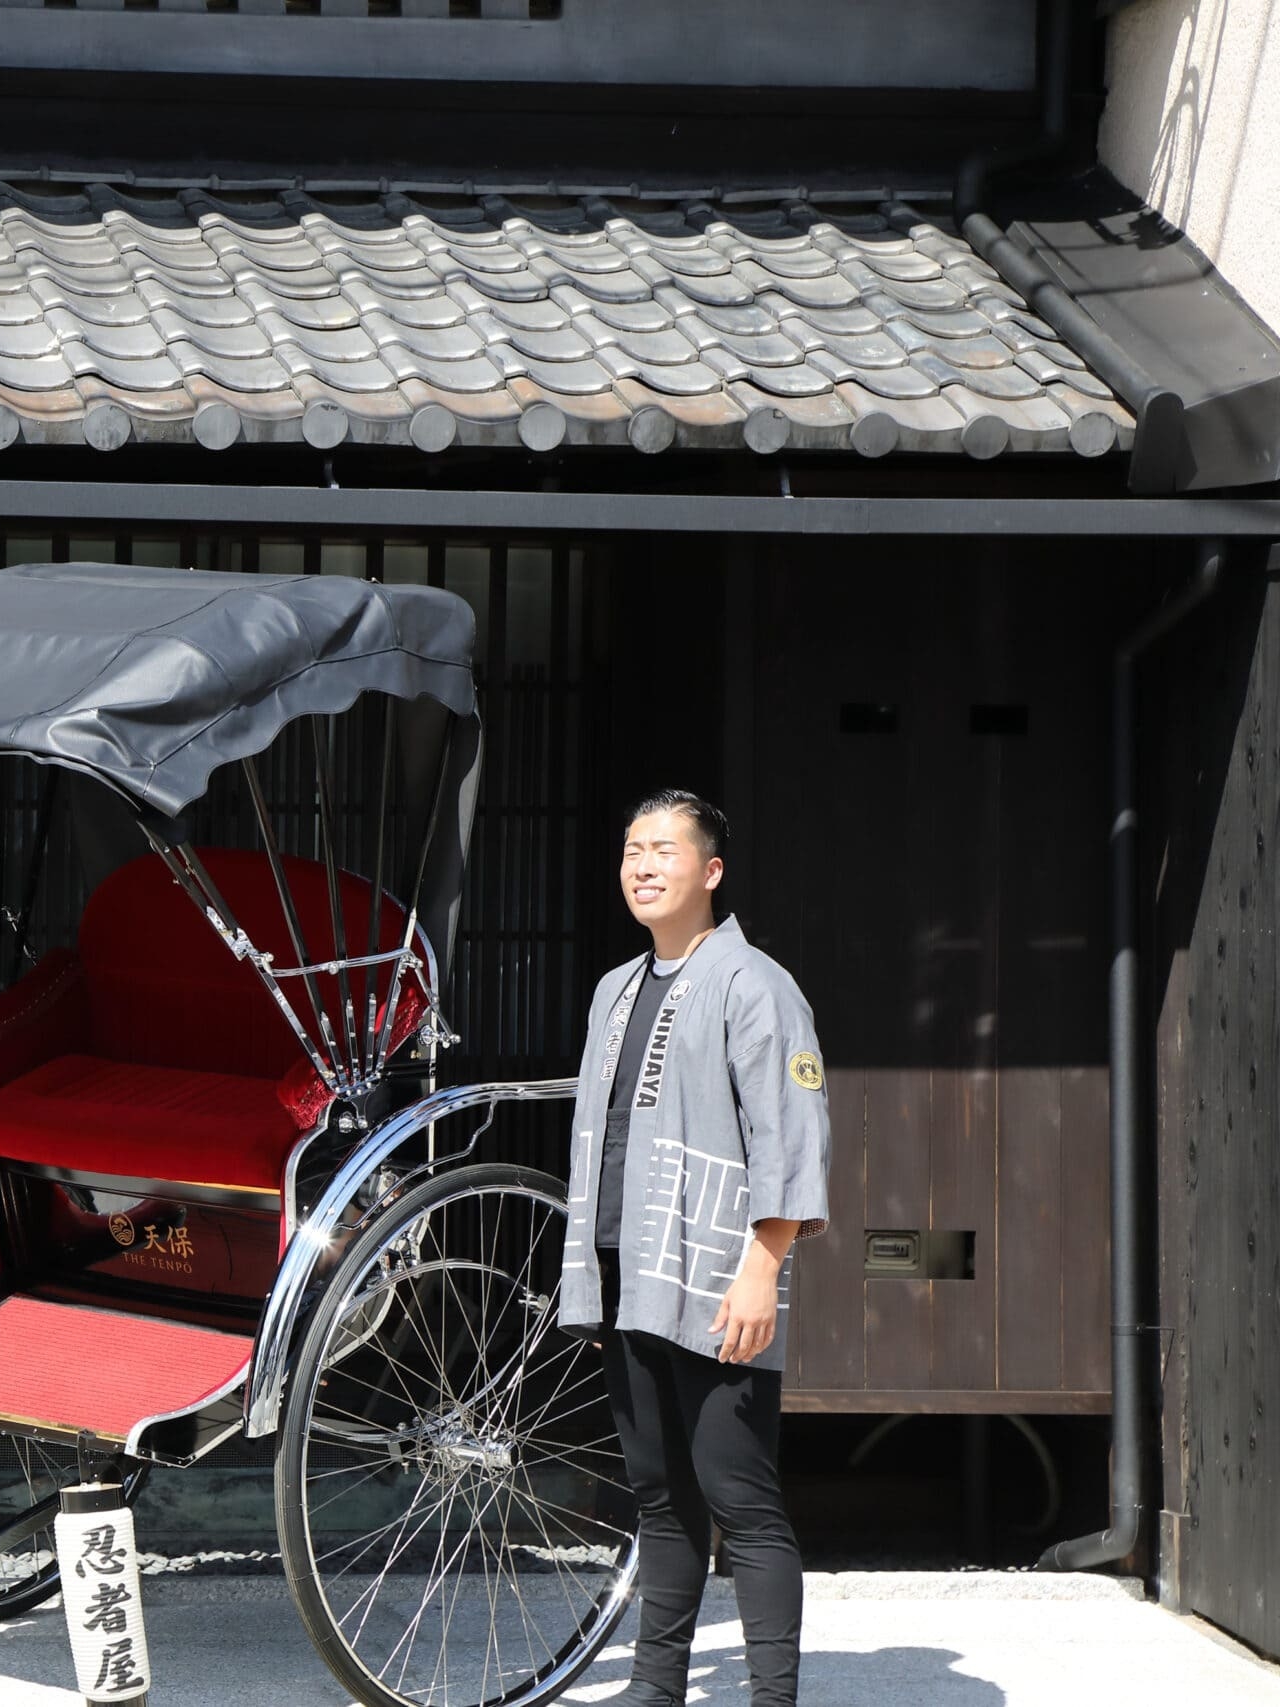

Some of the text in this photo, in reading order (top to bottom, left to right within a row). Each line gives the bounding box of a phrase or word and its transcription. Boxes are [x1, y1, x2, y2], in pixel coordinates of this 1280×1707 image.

[636, 1008, 676, 1108] NINJAYA
[122, 1252, 146, 1265] THE
[144, 1225, 194, 1258] 天保
[75, 1524, 144, 1693] 忍者屋
